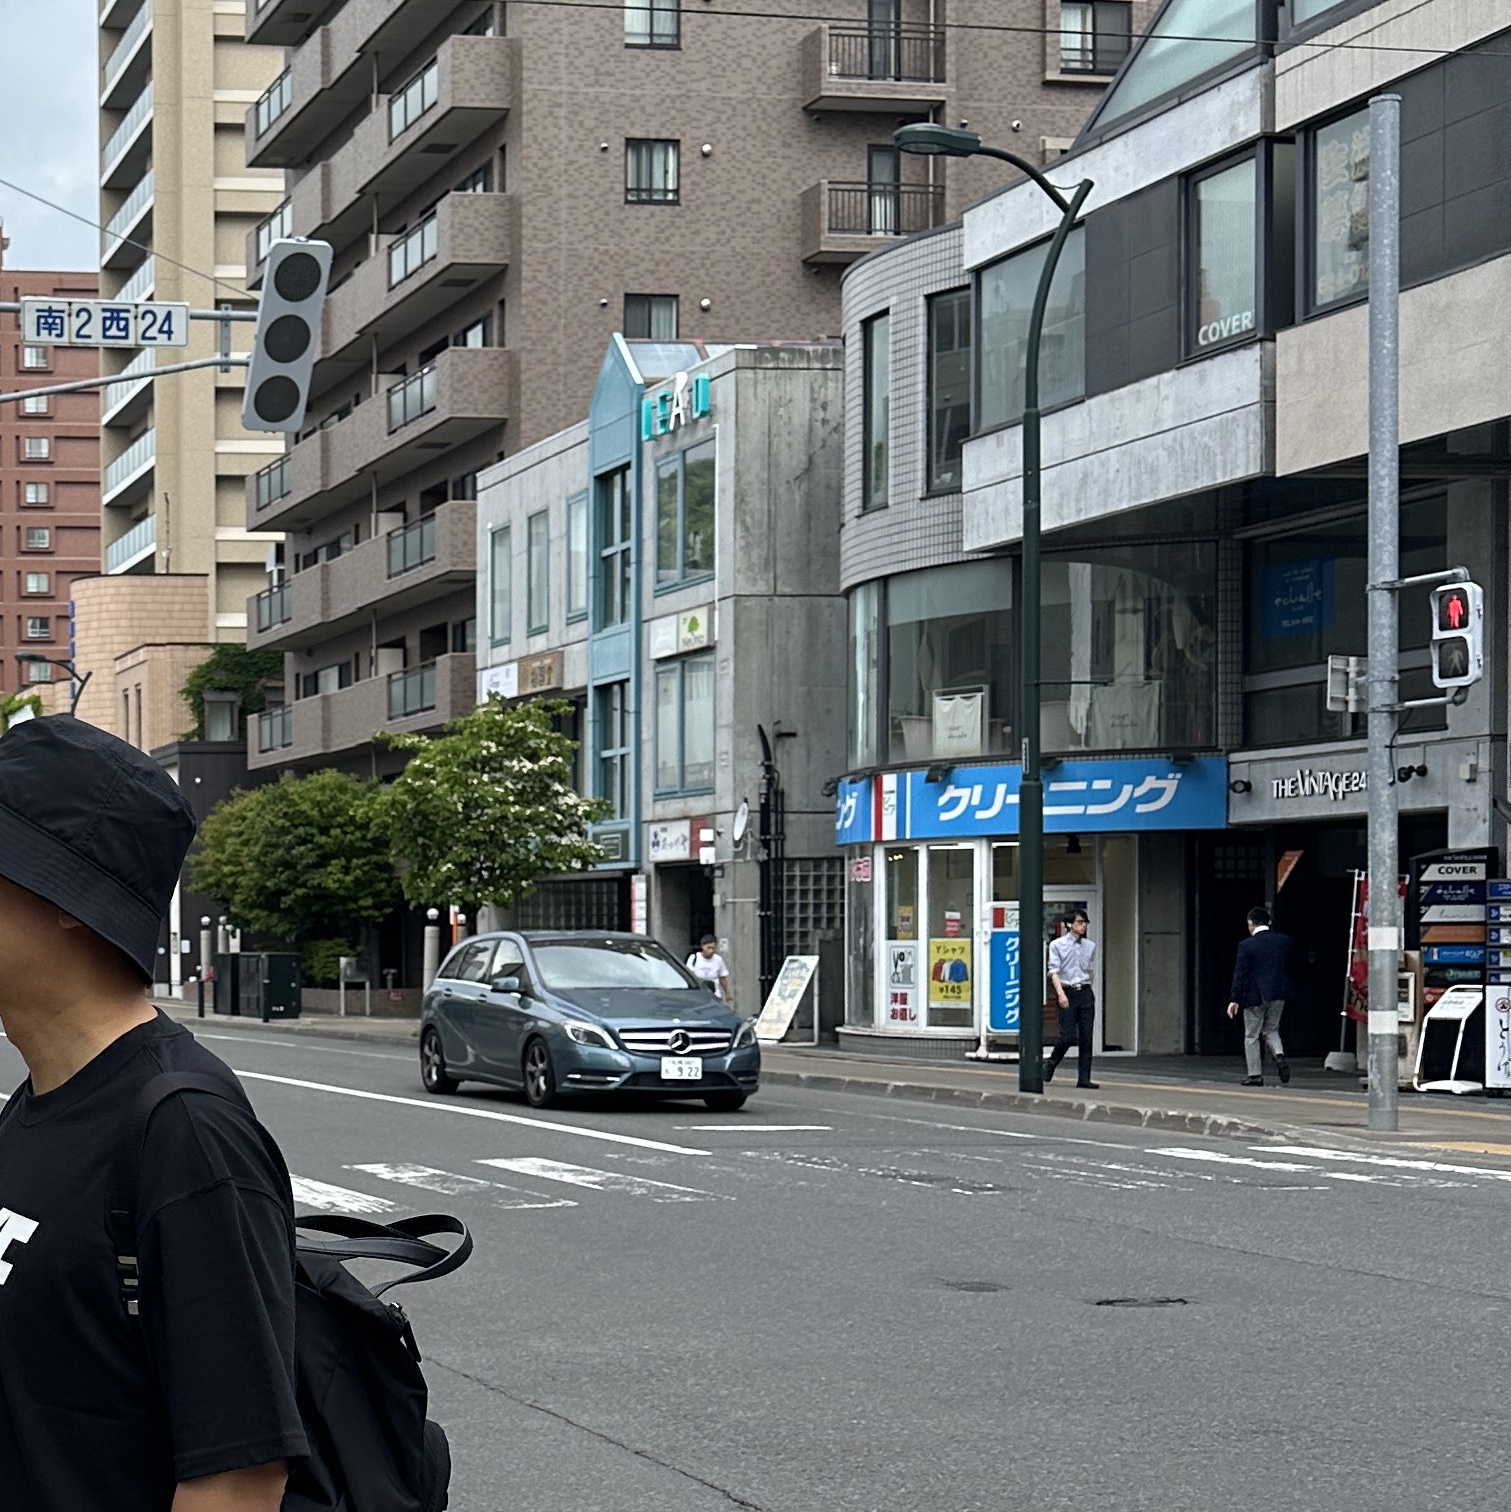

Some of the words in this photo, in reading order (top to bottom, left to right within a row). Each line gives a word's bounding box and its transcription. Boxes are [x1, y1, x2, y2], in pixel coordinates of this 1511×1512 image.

[35, 305, 174, 342] 南2西24
[1198, 311, 1253, 346] COVER
[1437, 866, 1478, 875] COVER
